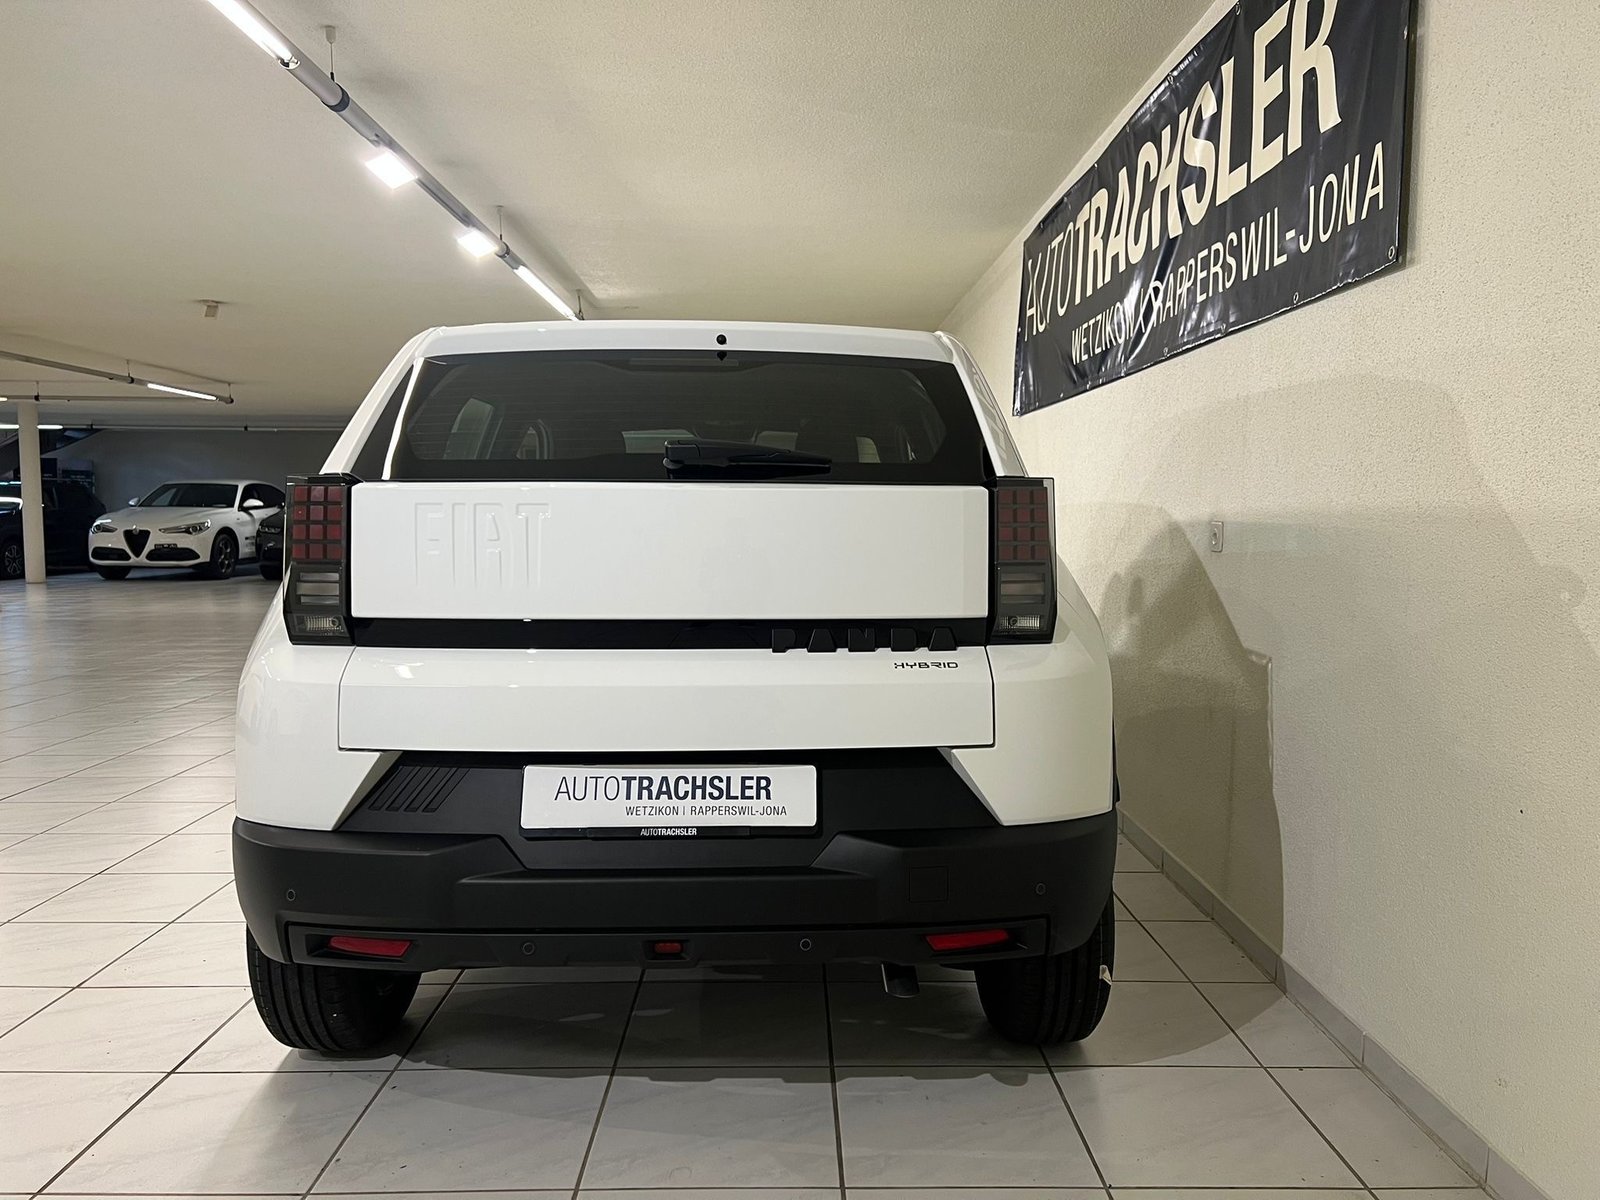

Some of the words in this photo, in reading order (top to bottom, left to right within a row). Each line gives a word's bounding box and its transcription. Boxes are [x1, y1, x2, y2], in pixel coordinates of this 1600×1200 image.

[1024, 0, 1342, 341] AUTOTRACHSLER
[1071, 297, 1138, 366] WETZIKON
[1150, 141, 1384, 328] RAPPERSWIL-JONA
[414, 502, 551, 588] FIAT
[771, 627, 957, 653] PANDA
[894, 661, 959, 669] HYBRID
[554, 775, 772, 801] AUTOTRACHSLER
[625, 805, 679, 816] WETZIKON
[690, 805, 787, 816] RAPPERSWIL-JONA
[640, 827, 697, 836] AUTOTRACHSLER
